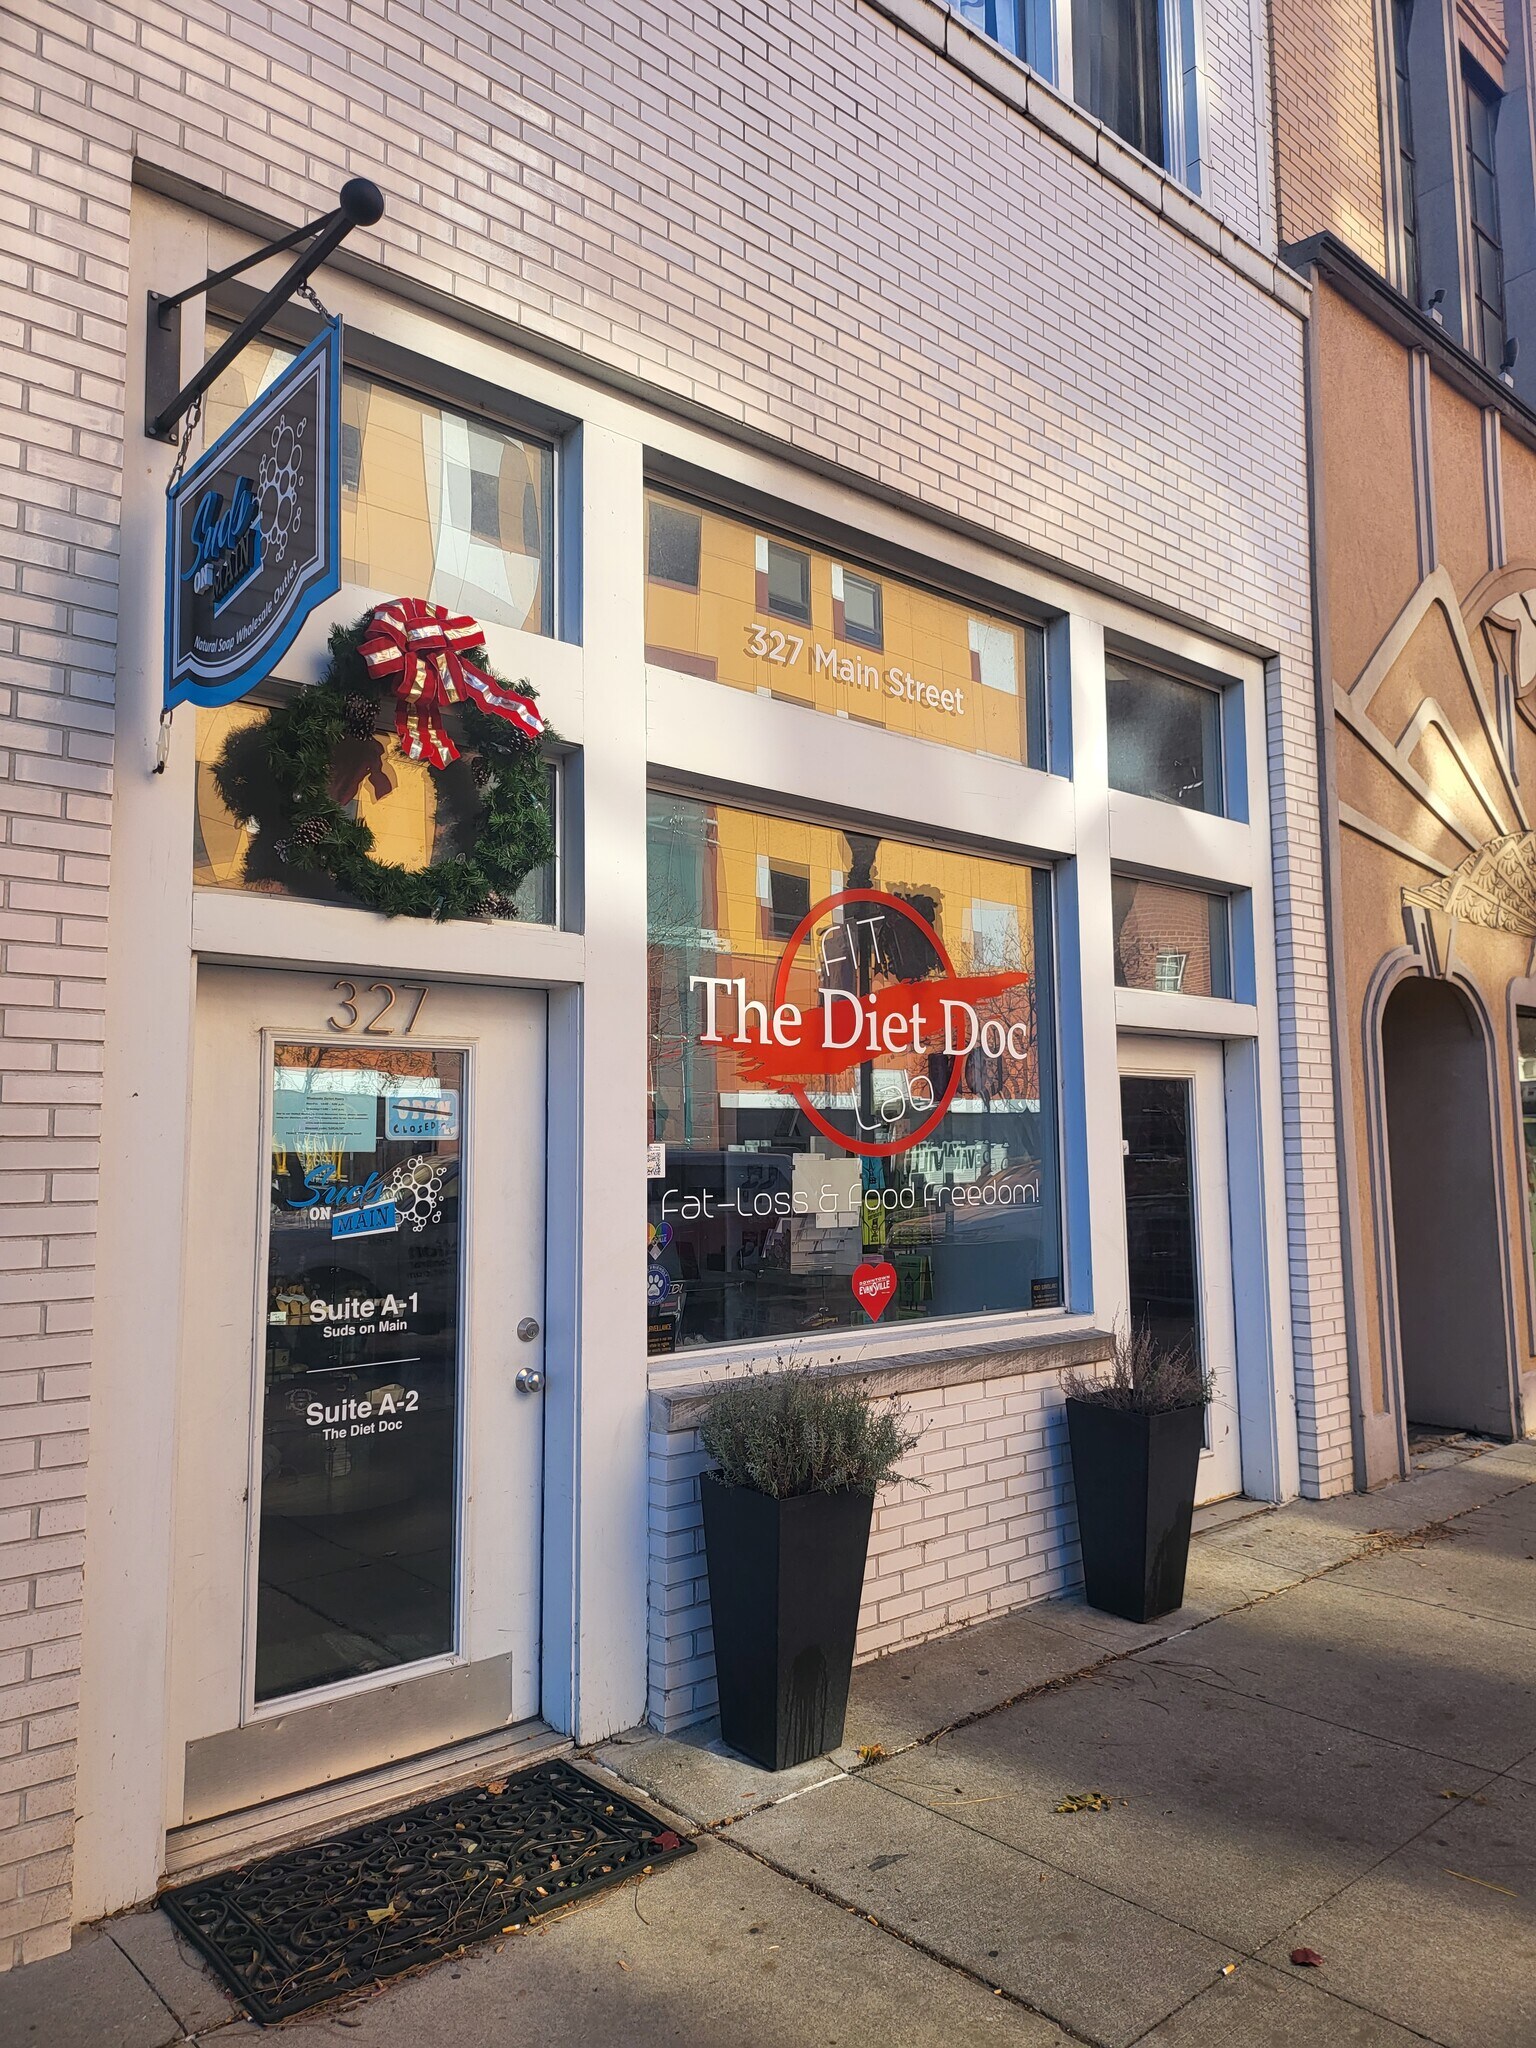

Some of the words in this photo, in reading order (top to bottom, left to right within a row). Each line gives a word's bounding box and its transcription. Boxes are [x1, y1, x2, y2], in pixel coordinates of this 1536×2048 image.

[182, 475, 258, 581] Suds
[193, 563, 214, 595] ON
[213, 527, 256, 601] MAIN
[194, 635, 218, 653] Natural
[218, 636, 235, 652] Soap
[236, 600, 273, 645] Wholesale
[273, 560, 298, 605] Outlet
[750, 623, 804, 665] 327
[815, 643, 878, 690] Main
[889, 667, 965, 716] Street
[328, 980, 430, 1034] 327
[689, 975, 802, 1046] The
[818, 987, 927, 1055] Diet
[939, 999, 1028, 1060] Doc
[397, 1098, 452, 1121] OPEN
[393, 1121, 436, 1134] CLOSED
[286, 1163, 385, 1208] Suds
[818, 1183, 840, 1213] &
[309, 1206, 332, 1221] ON
[337, 1206, 390, 1233] MAIN
[859, 1275, 891, 1286] DOWNTOWN
[859, 1280, 891, 1297] EVANSVILLE
[309, 1297, 375, 1323] Suite
[381, 1292, 418, 1316] A-1
[323, 1323, 356, 1338] Suds
[359, 1324, 375, 1334] on
[379, 1319, 408, 1333] Main
[306, 1398, 372, 1426] Suite
[378, 1390, 419, 1416] A-2
[323, 1428, 347, 1441] The
[350, 1422, 375, 1437] Diet
[379, 1419, 403, 1433] Doc
